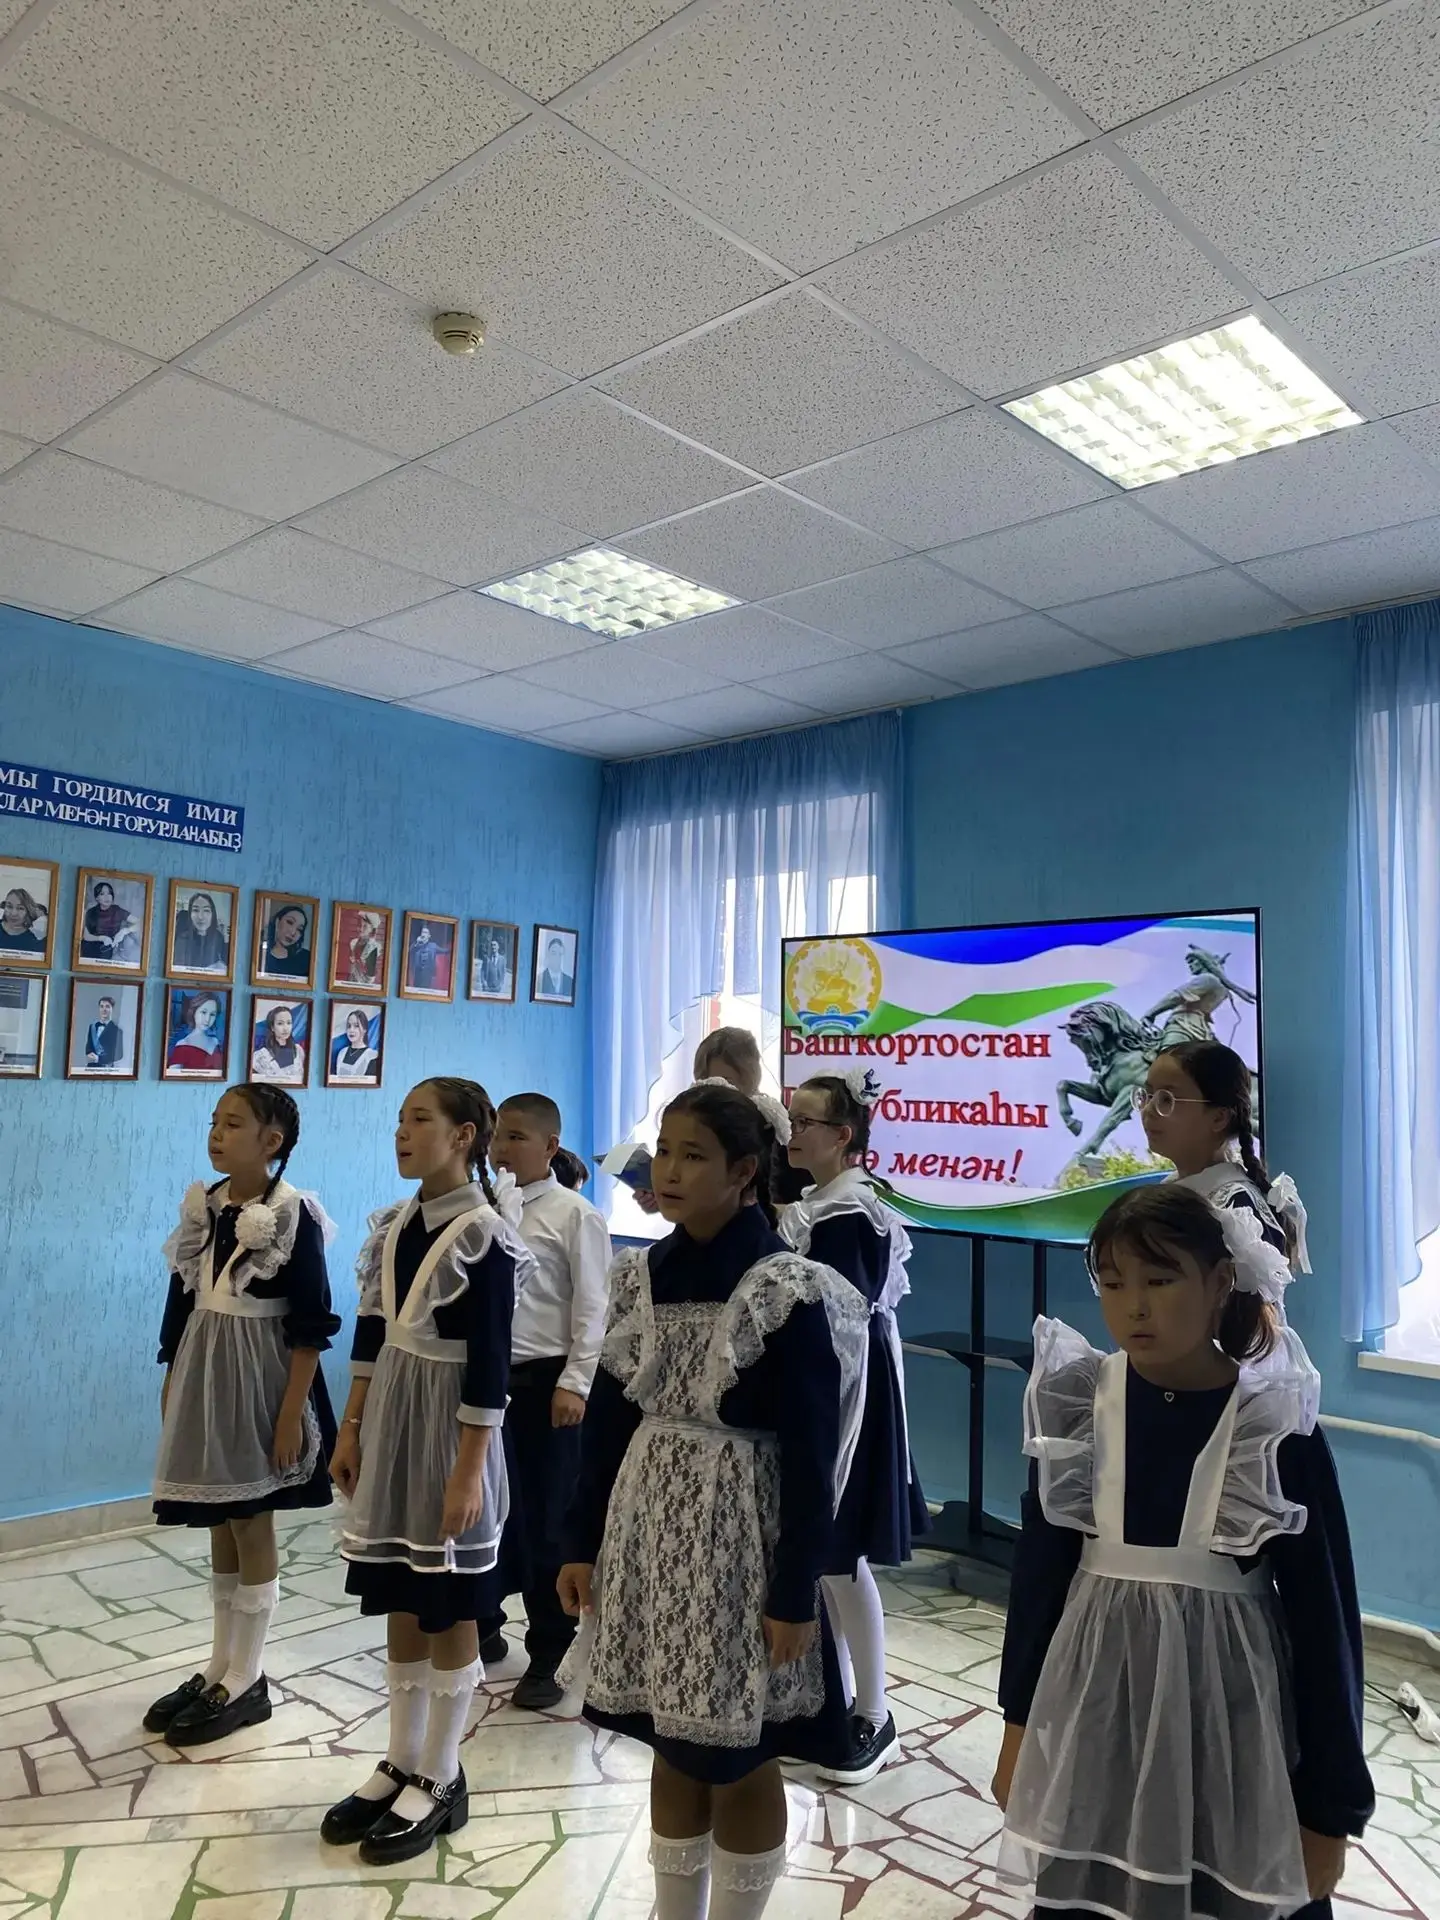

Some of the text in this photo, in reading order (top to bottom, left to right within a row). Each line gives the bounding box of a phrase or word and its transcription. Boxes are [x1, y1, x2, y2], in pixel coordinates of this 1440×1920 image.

[0, 767, 239, 826] МЫ ГОРДИМСЯ ИМИ
[0, 791, 242, 852] ЛАР МЕНӘН ҒОРУРЛАНАБЫҘ
[887, 1148, 1024, 1183] менән!
